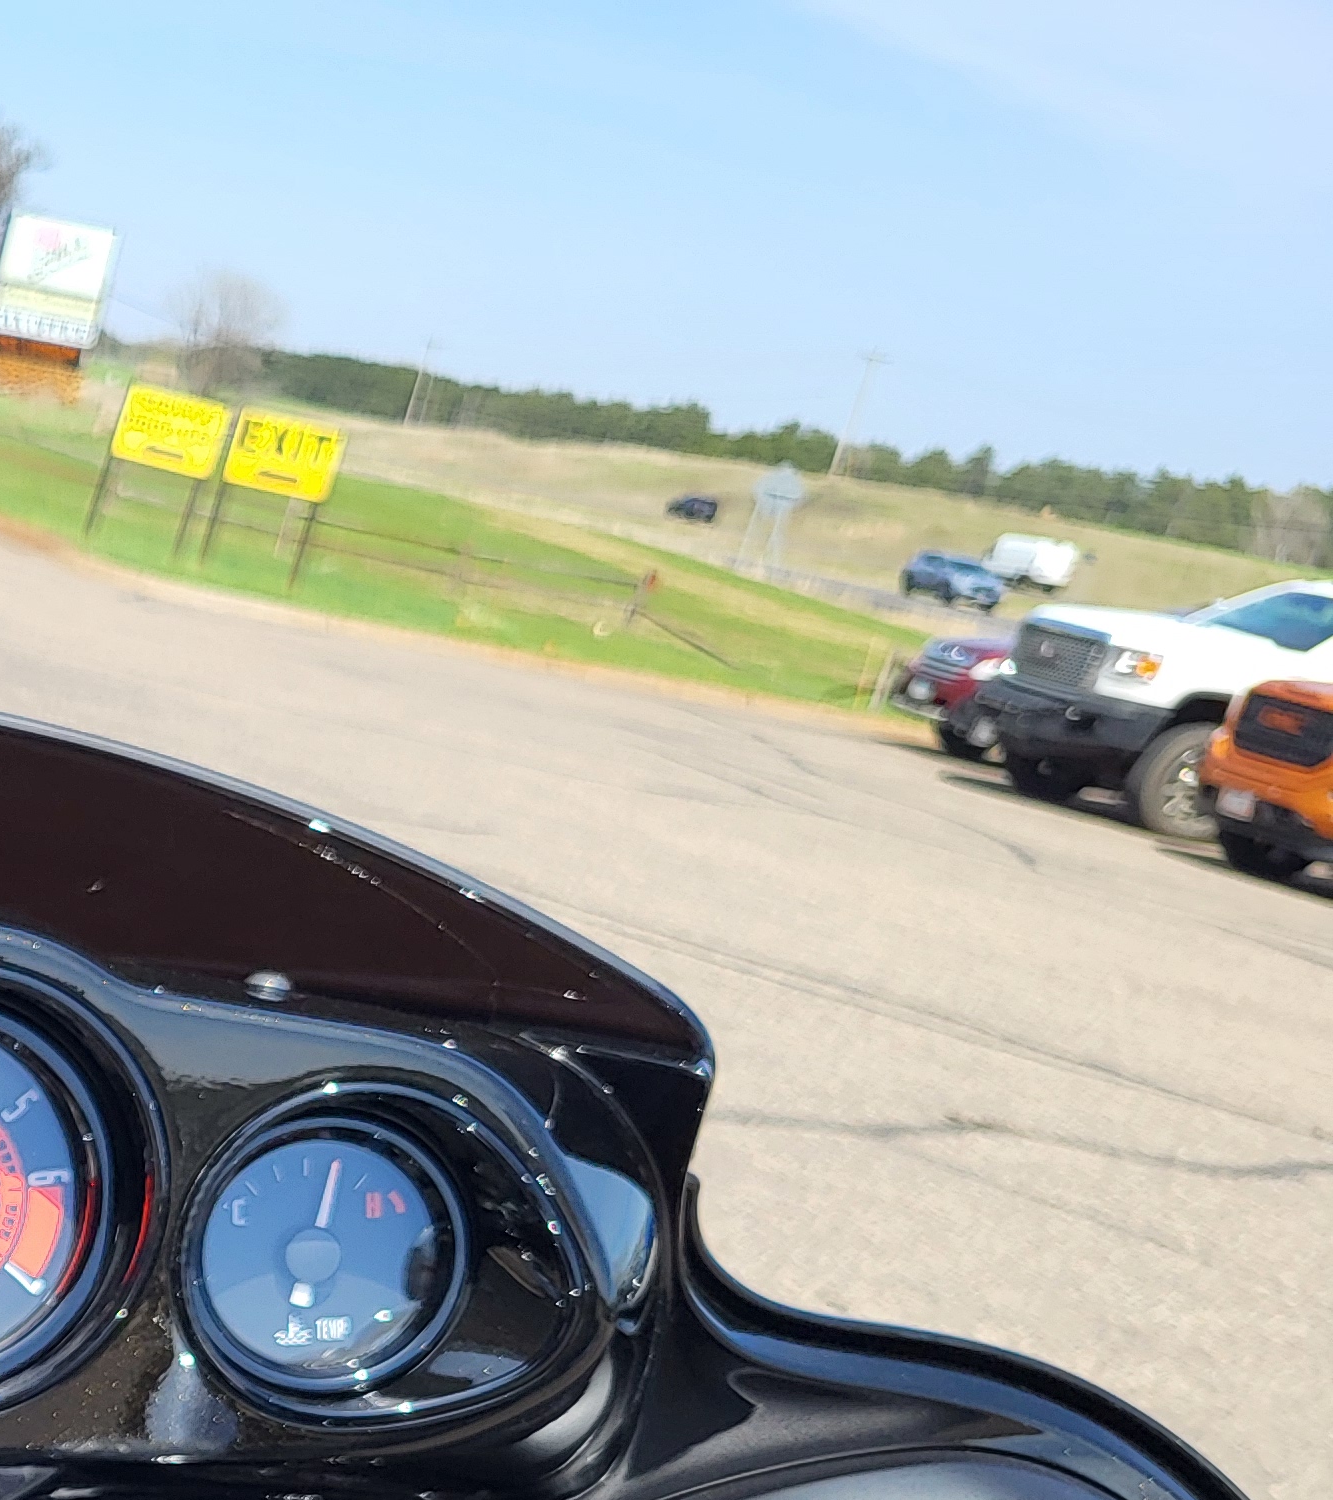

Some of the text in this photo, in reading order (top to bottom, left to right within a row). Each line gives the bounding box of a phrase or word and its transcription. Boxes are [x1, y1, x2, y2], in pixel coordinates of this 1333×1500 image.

[241, 419, 333, 462] EXIT
[0, 1088, 38, 1122] 5
[27, 1168, 71, 1187] 6
[231, 1197, 247, 1226] C
[365, 1191, 383, 1219] H
[3, 1262, 47, 1296] 7
[314, 1316, 352, 1341] TEMP
